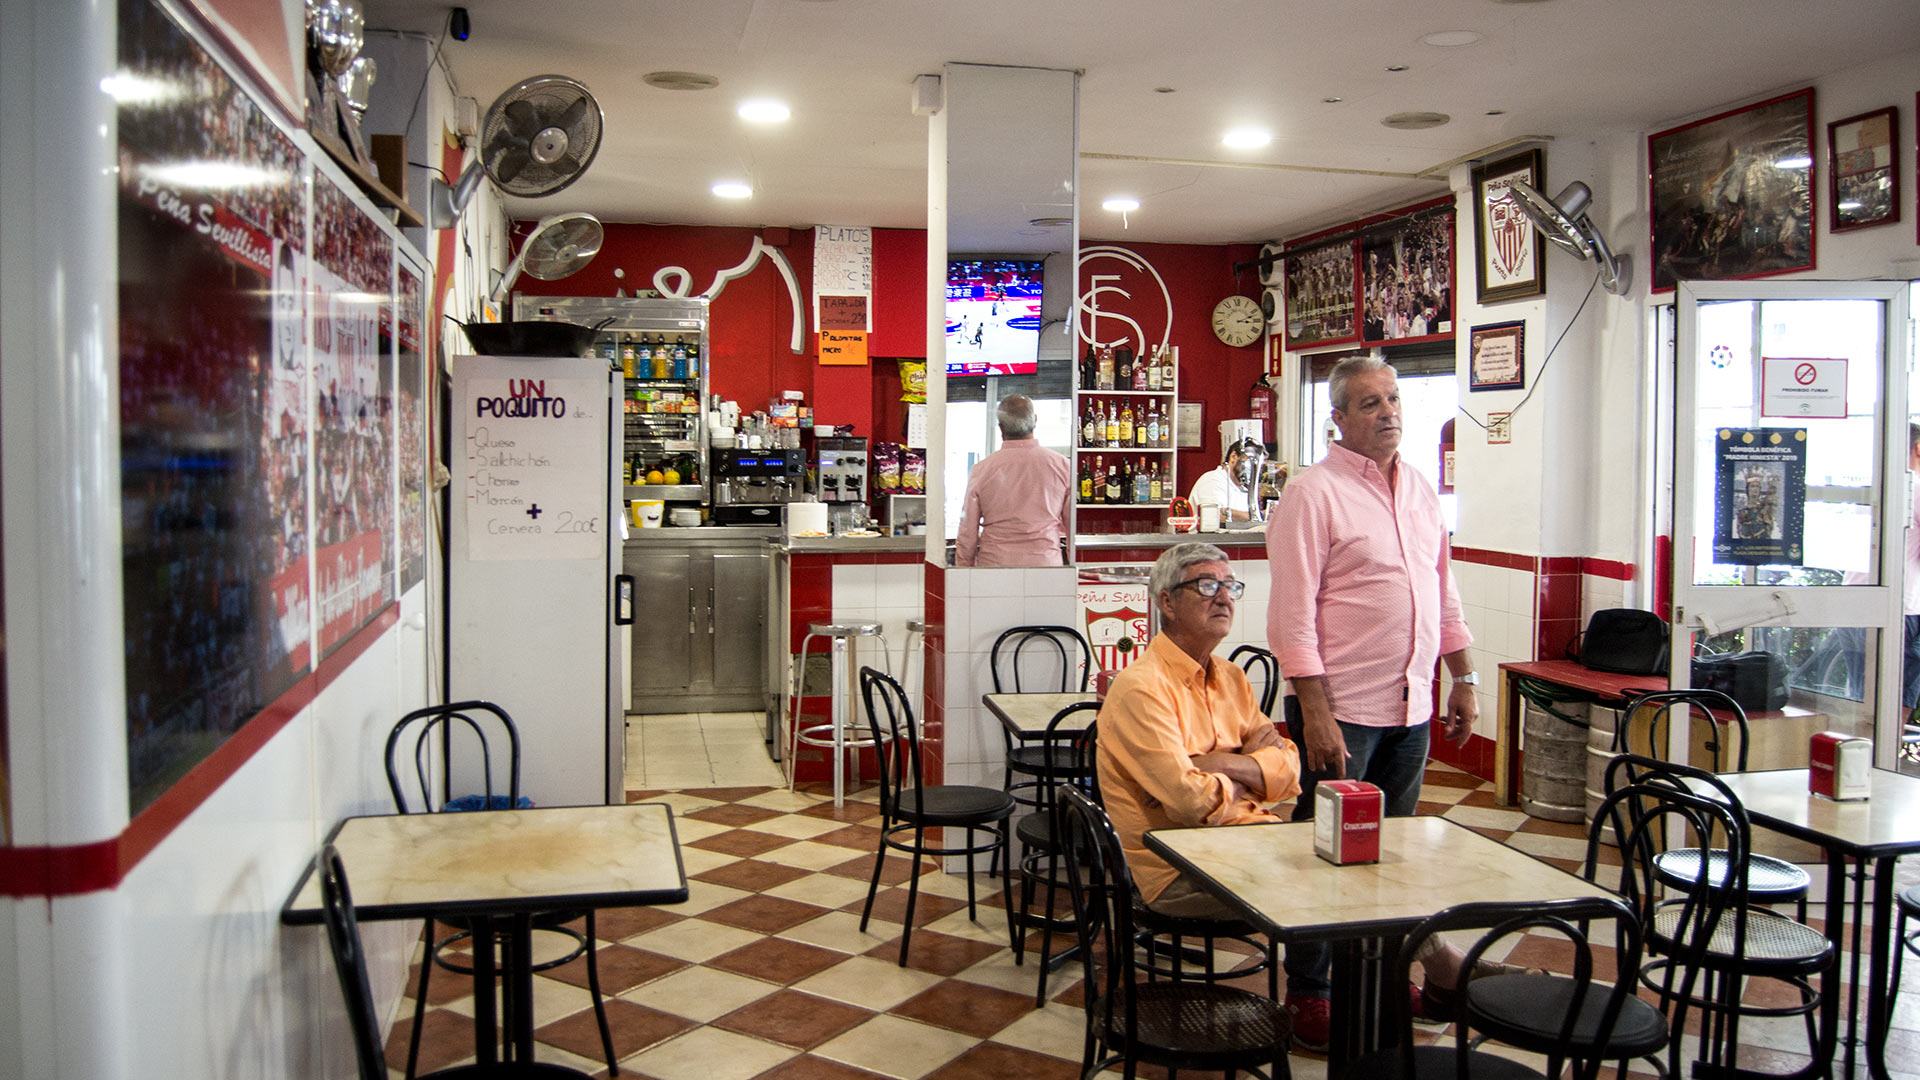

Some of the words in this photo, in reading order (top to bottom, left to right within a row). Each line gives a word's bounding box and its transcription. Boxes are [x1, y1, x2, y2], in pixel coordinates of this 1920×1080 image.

[138, 176, 192, 225] Peña
[196, 203, 272, 269] Sevillista
[818, 225, 869, 243] PLATOS
[509, 378, 545, 399] UN
[477, 397, 566, 419] POQUITO
[526, 503, 542, 520] +
[487, 518, 543, 535] Cerveza
[1343, 821, 1379, 831] Cruzcampo
